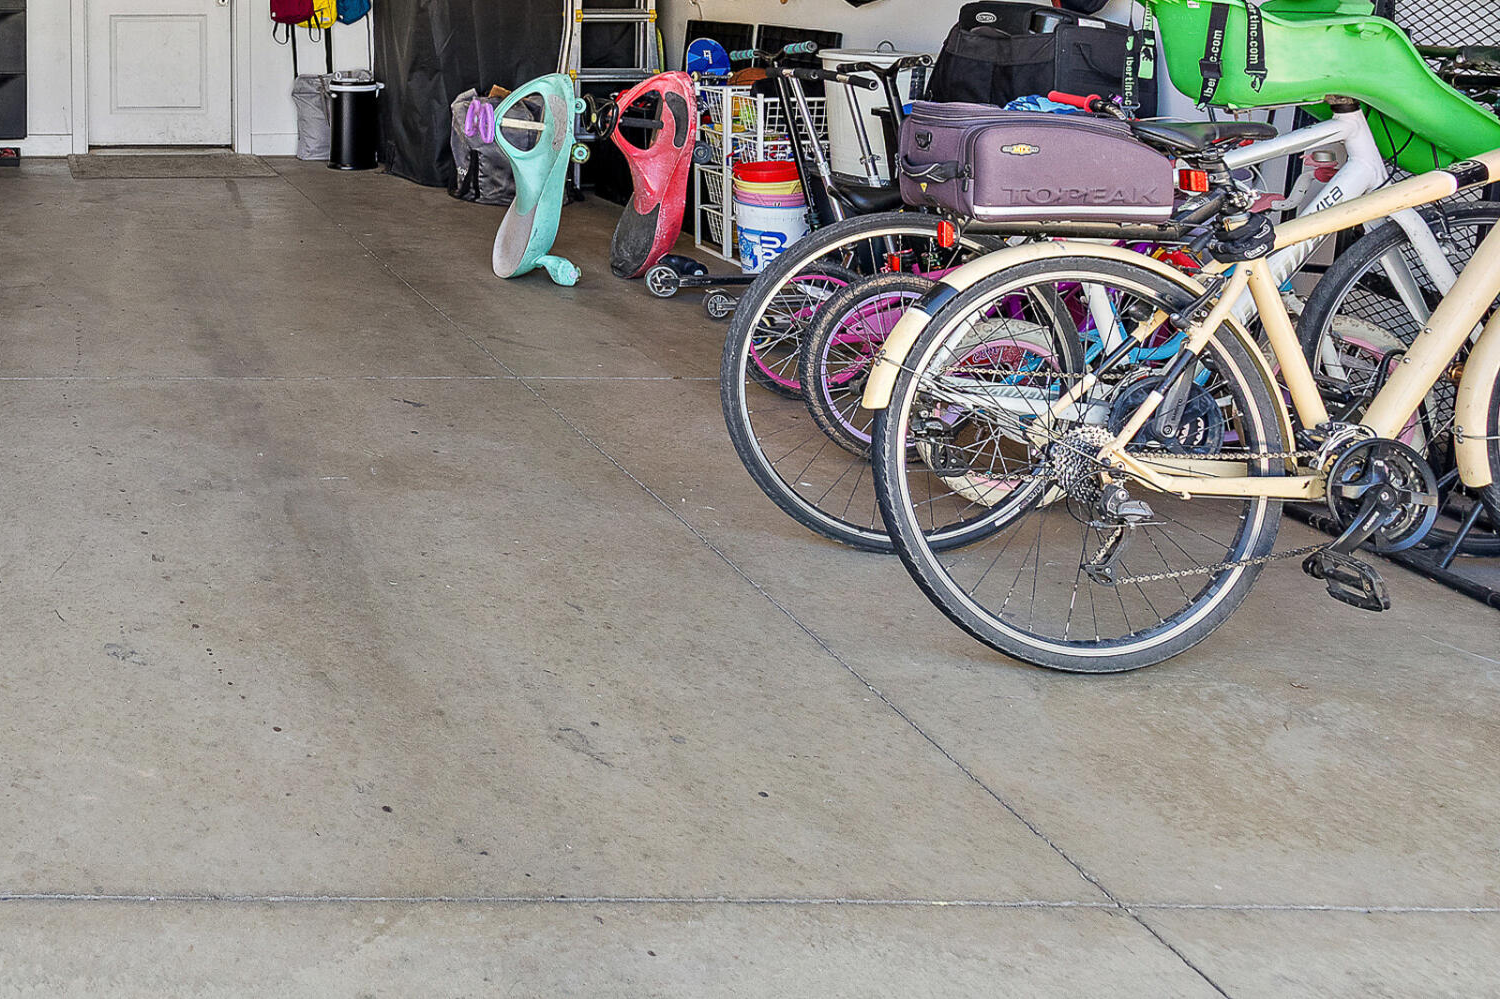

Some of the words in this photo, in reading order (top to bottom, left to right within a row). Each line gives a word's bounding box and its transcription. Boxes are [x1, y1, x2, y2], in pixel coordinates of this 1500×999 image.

[1210, 29, 1223, 63] c.com
[1247, 3, 1260, 65] ertinc.com
[1001, 187, 1161, 205] TOPEAK
